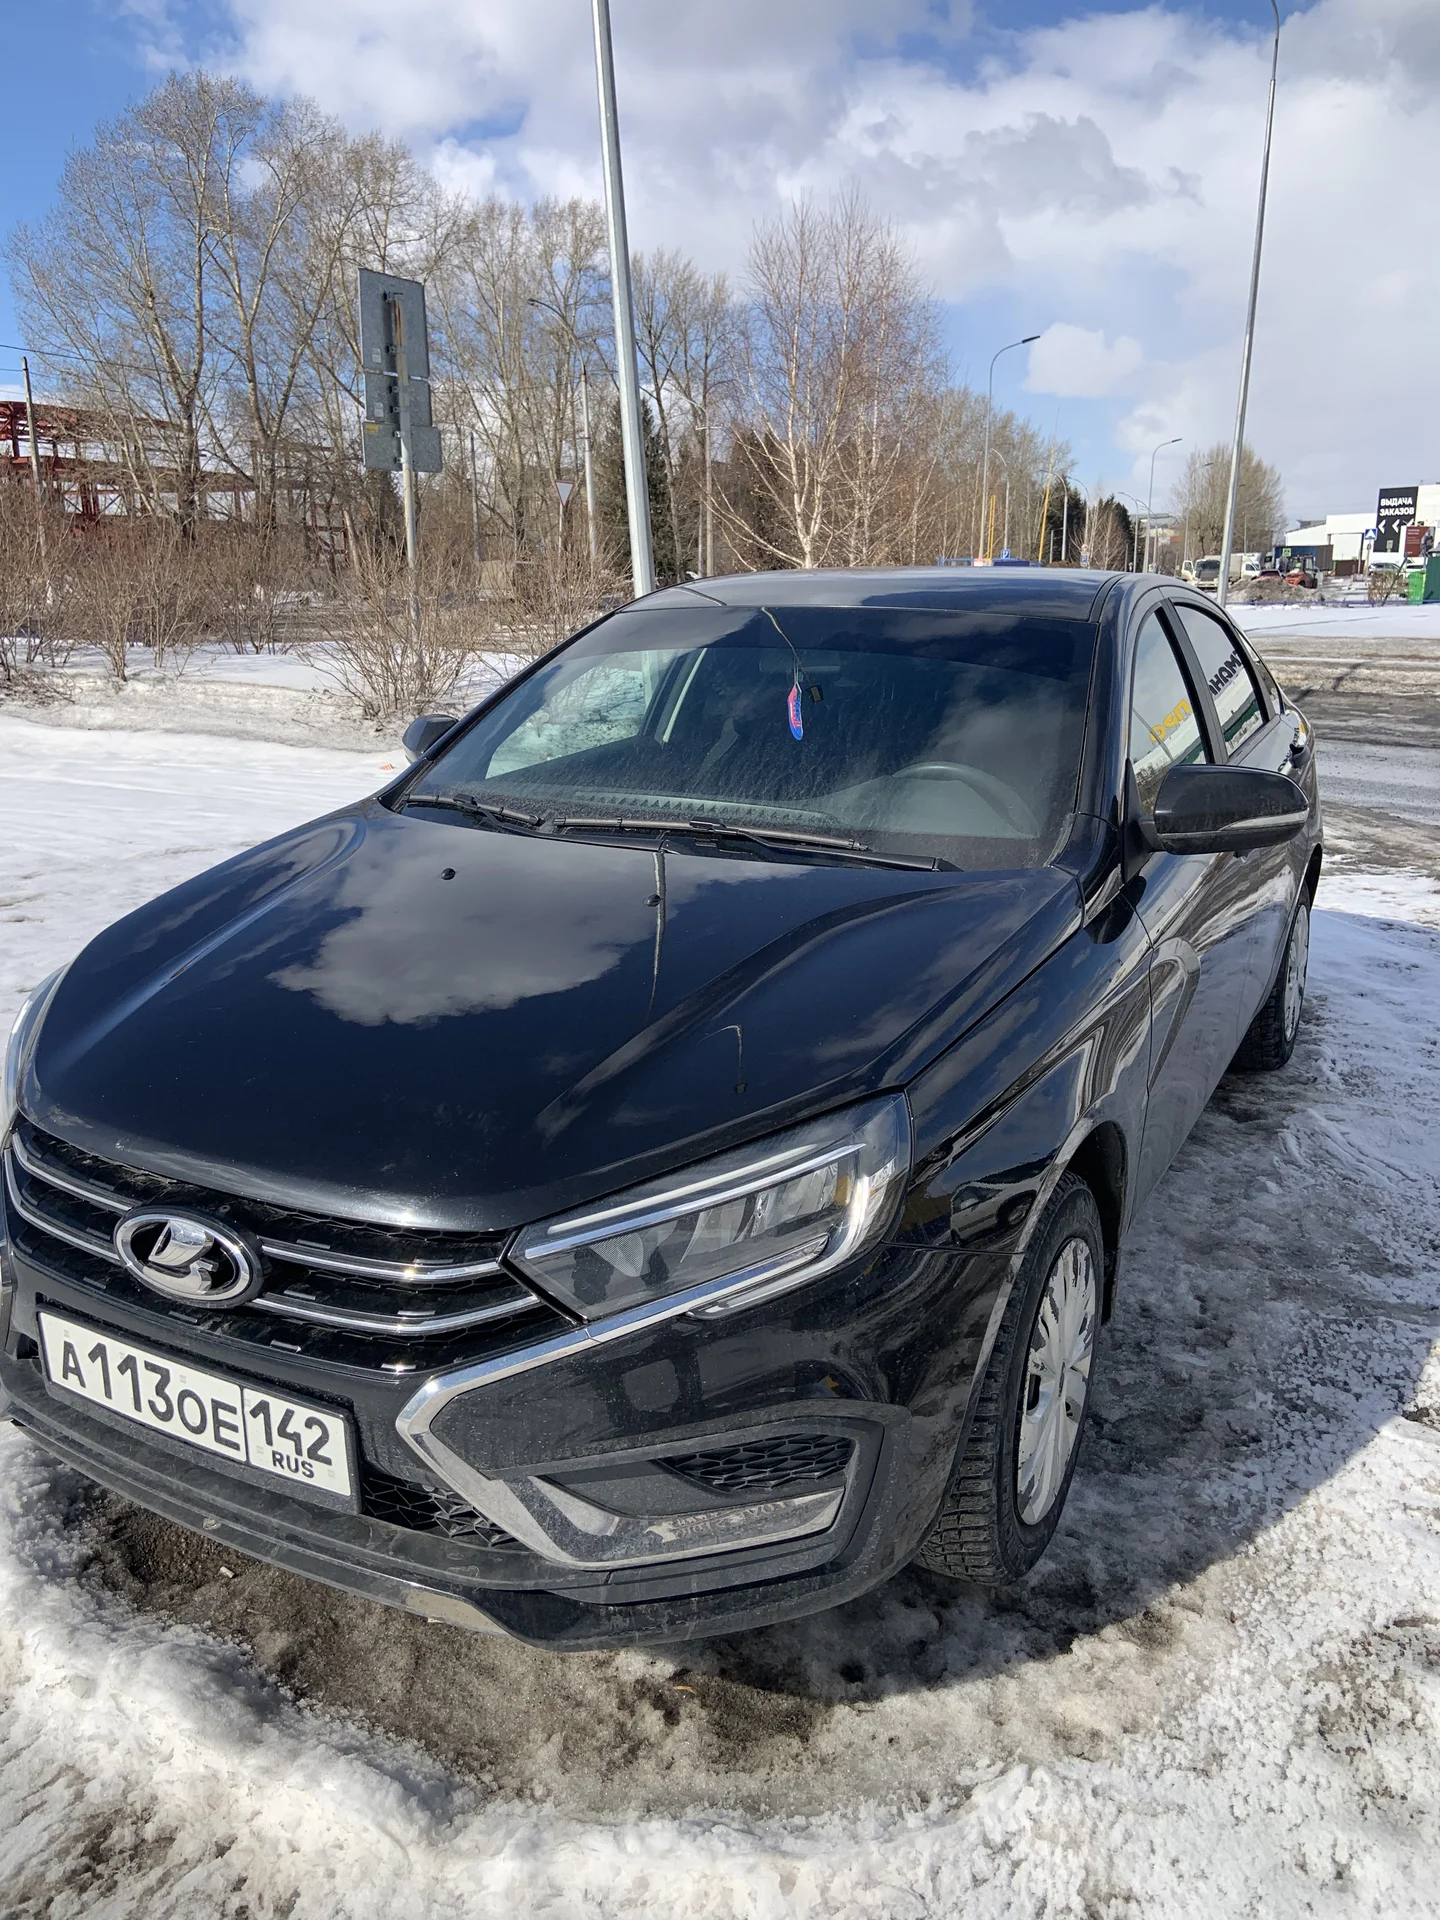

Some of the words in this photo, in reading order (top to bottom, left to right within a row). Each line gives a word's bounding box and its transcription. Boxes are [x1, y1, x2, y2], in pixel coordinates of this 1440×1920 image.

[1380, 497, 1413, 507] ВЫДАЧА
[1379, 507, 1415, 517] ЗАКАЗОВ
[62, 1340, 241, 1451] А113ОЕ
[249, 1399, 332, 1466] 142
[272, 1450, 315, 1479] RUS
